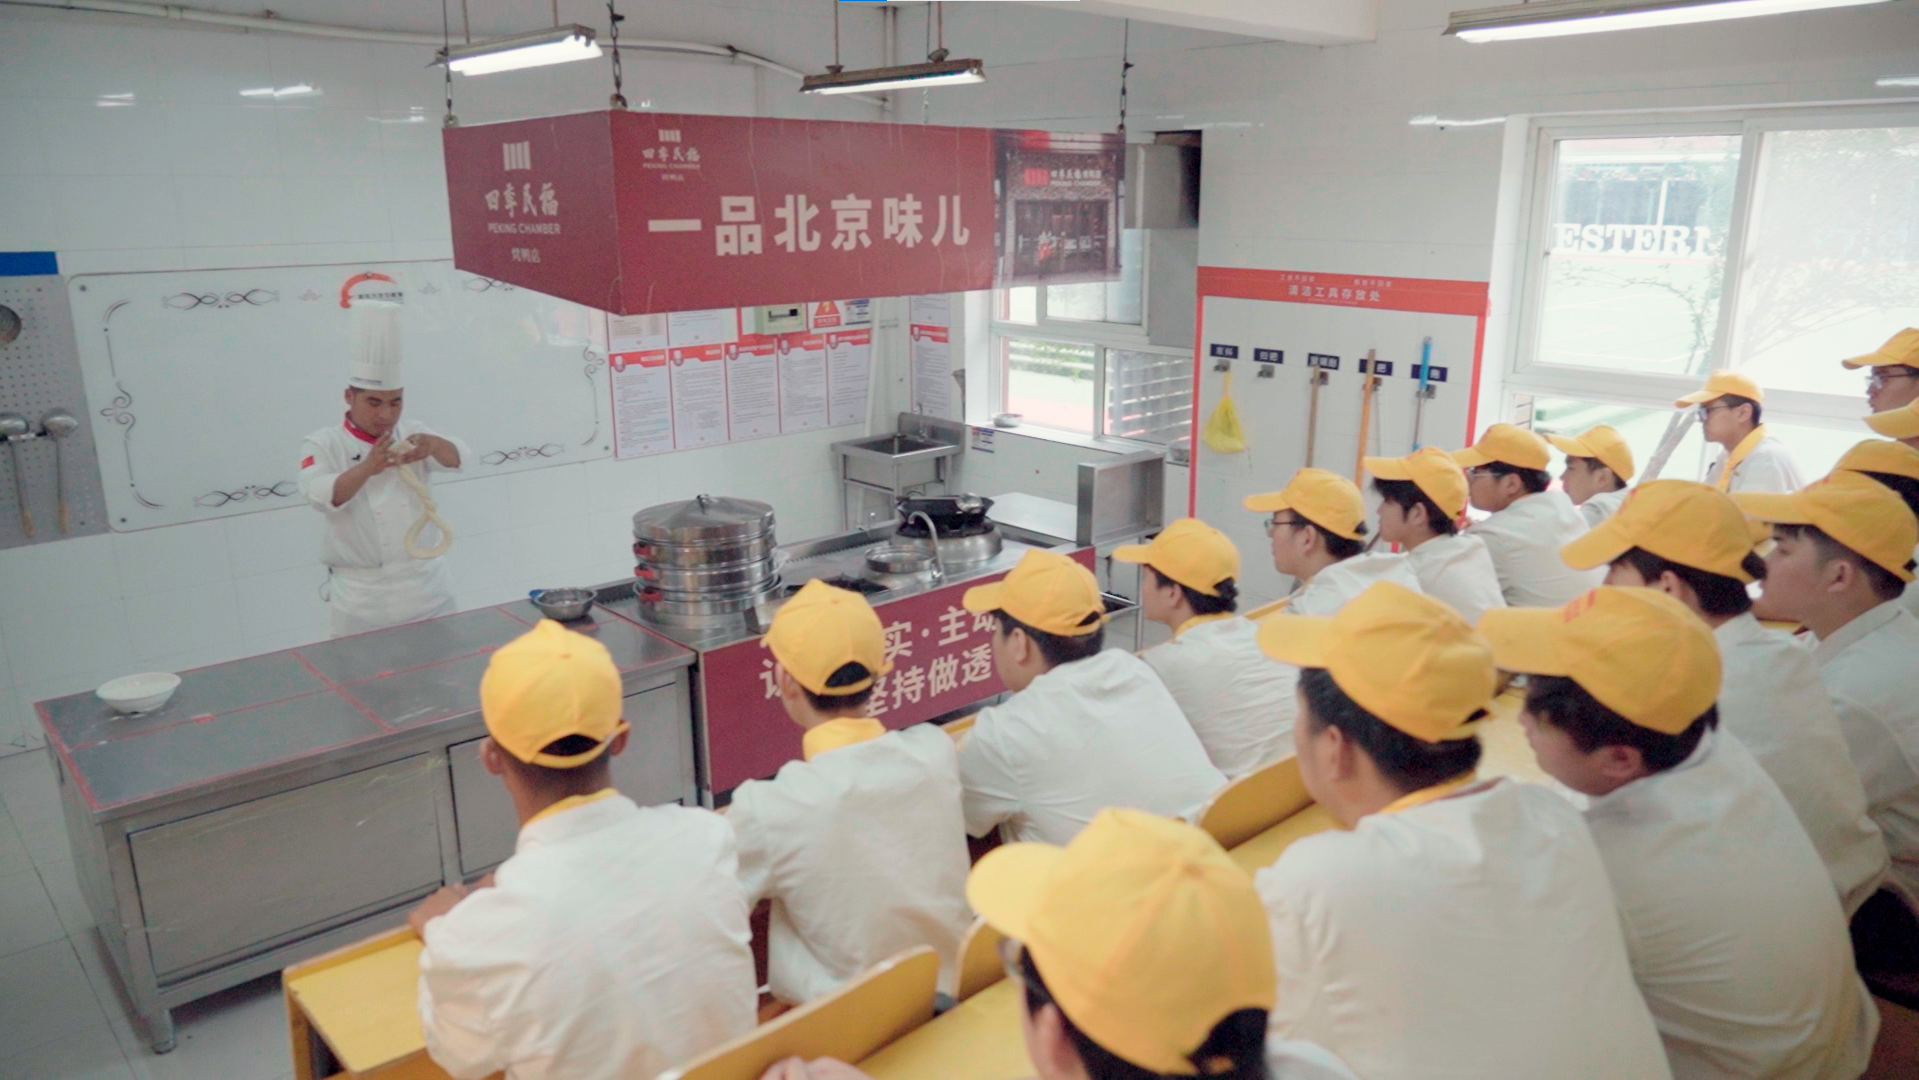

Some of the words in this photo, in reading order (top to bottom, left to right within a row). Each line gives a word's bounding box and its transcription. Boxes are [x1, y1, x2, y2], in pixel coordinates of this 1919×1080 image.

[485, 182, 559, 218] 四季民福
[488, 222, 517, 234] PEKING
[519, 223, 561, 235] CHAMBER
[648, 193, 970, 257] 一品北京味儿
